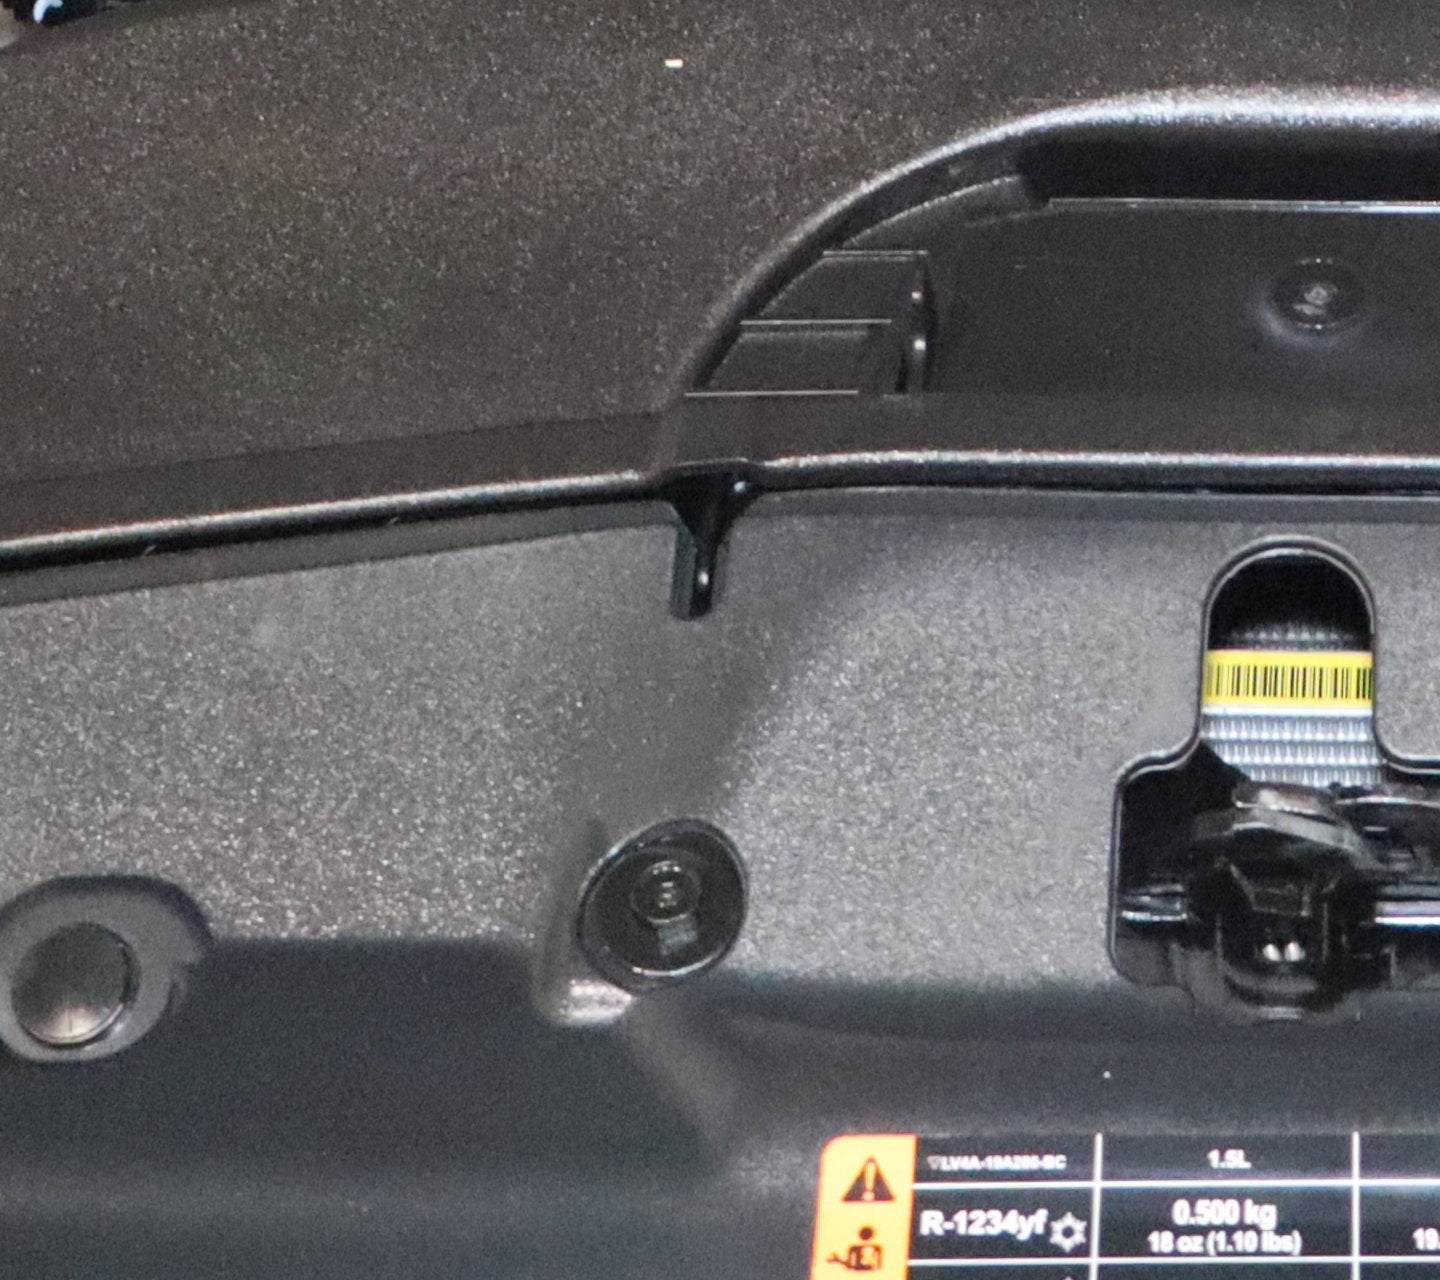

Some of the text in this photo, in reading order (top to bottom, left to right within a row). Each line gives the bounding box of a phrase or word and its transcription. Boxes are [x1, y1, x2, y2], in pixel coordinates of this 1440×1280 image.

[1208, 1149, 1252, 1169] 1.5L
[920, 1208, 1049, 1241] R-1234yf
[1172, 1198, 1278, 1230] 0.500 kg
[1176, 1234, 1204, 1253] oz
[1206, 1229, 1259, 1256] (1.10
[1261, 1228, 1303, 1256] lbs)
